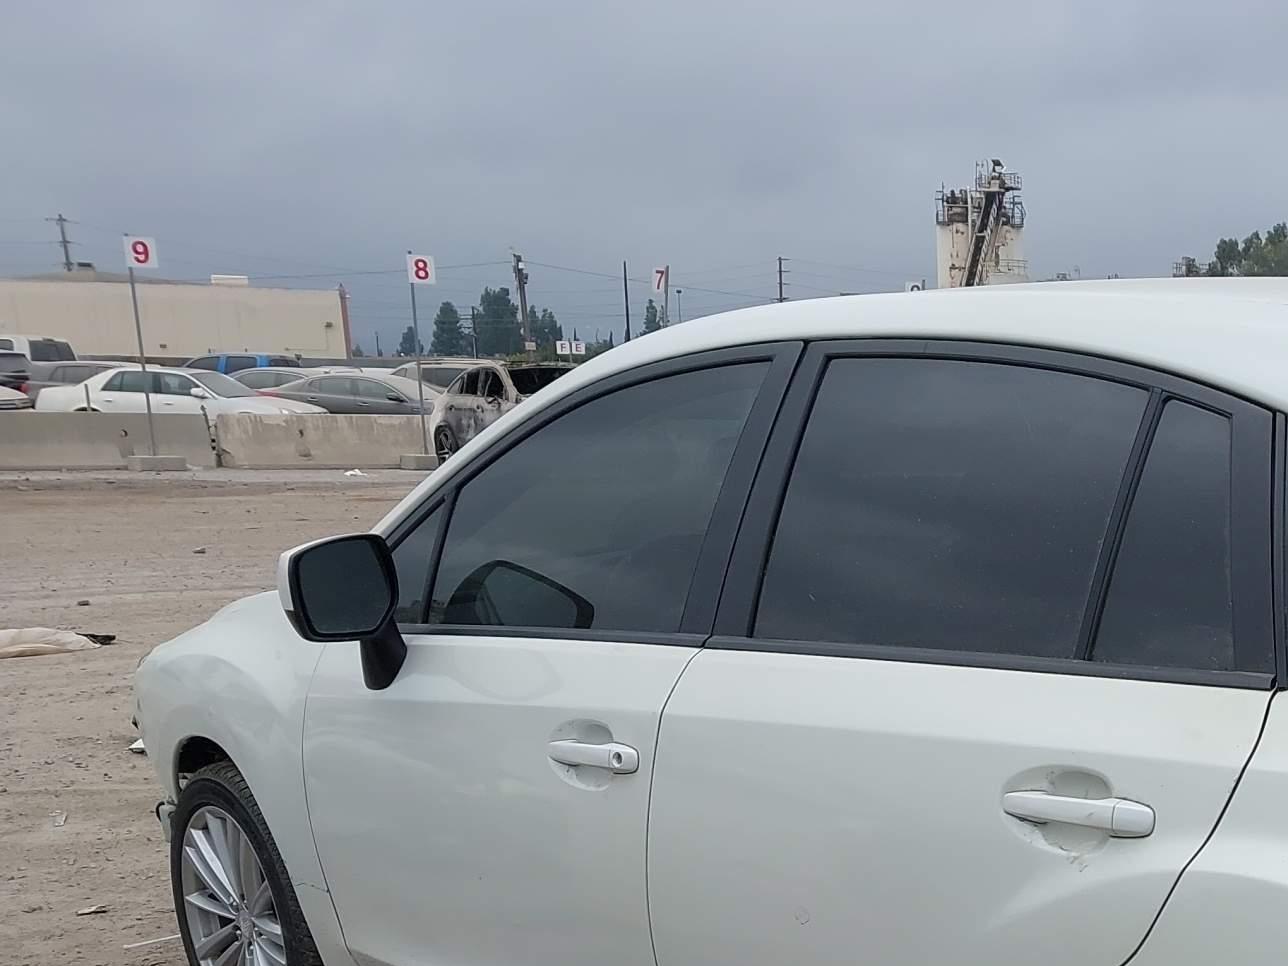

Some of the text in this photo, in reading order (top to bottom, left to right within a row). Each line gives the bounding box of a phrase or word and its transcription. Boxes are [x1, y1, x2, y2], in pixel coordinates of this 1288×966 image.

[131, 240, 149, 264] 9
[414, 258, 429, 280] 8
[655, 269, 665, 290] 7
[560, 343, 567, 352] F
[575, 343, 582, 353] E
